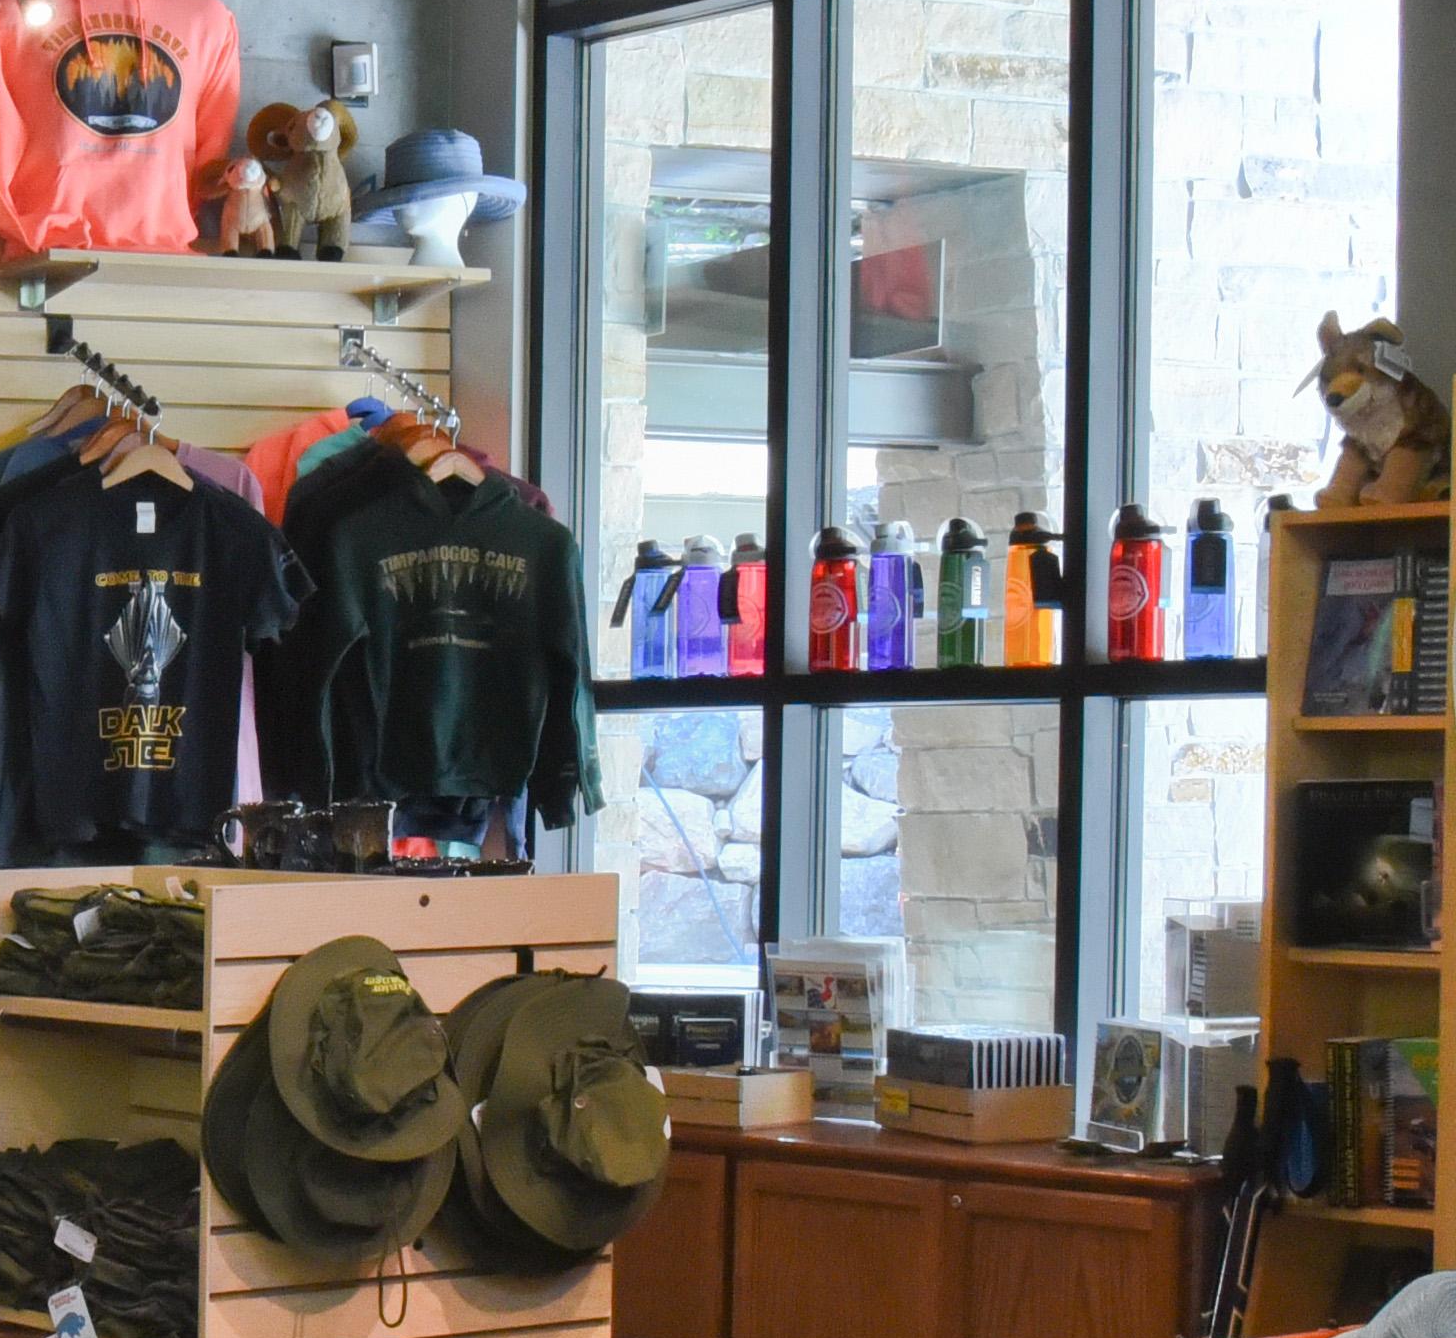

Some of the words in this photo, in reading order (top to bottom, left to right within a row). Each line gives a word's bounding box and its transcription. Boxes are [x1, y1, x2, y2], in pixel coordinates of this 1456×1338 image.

[378, 545, 480, 574] TIMPANOGOS
[485, 550, 526, 574] CAVE
[147, 569, 168, 582] TO
